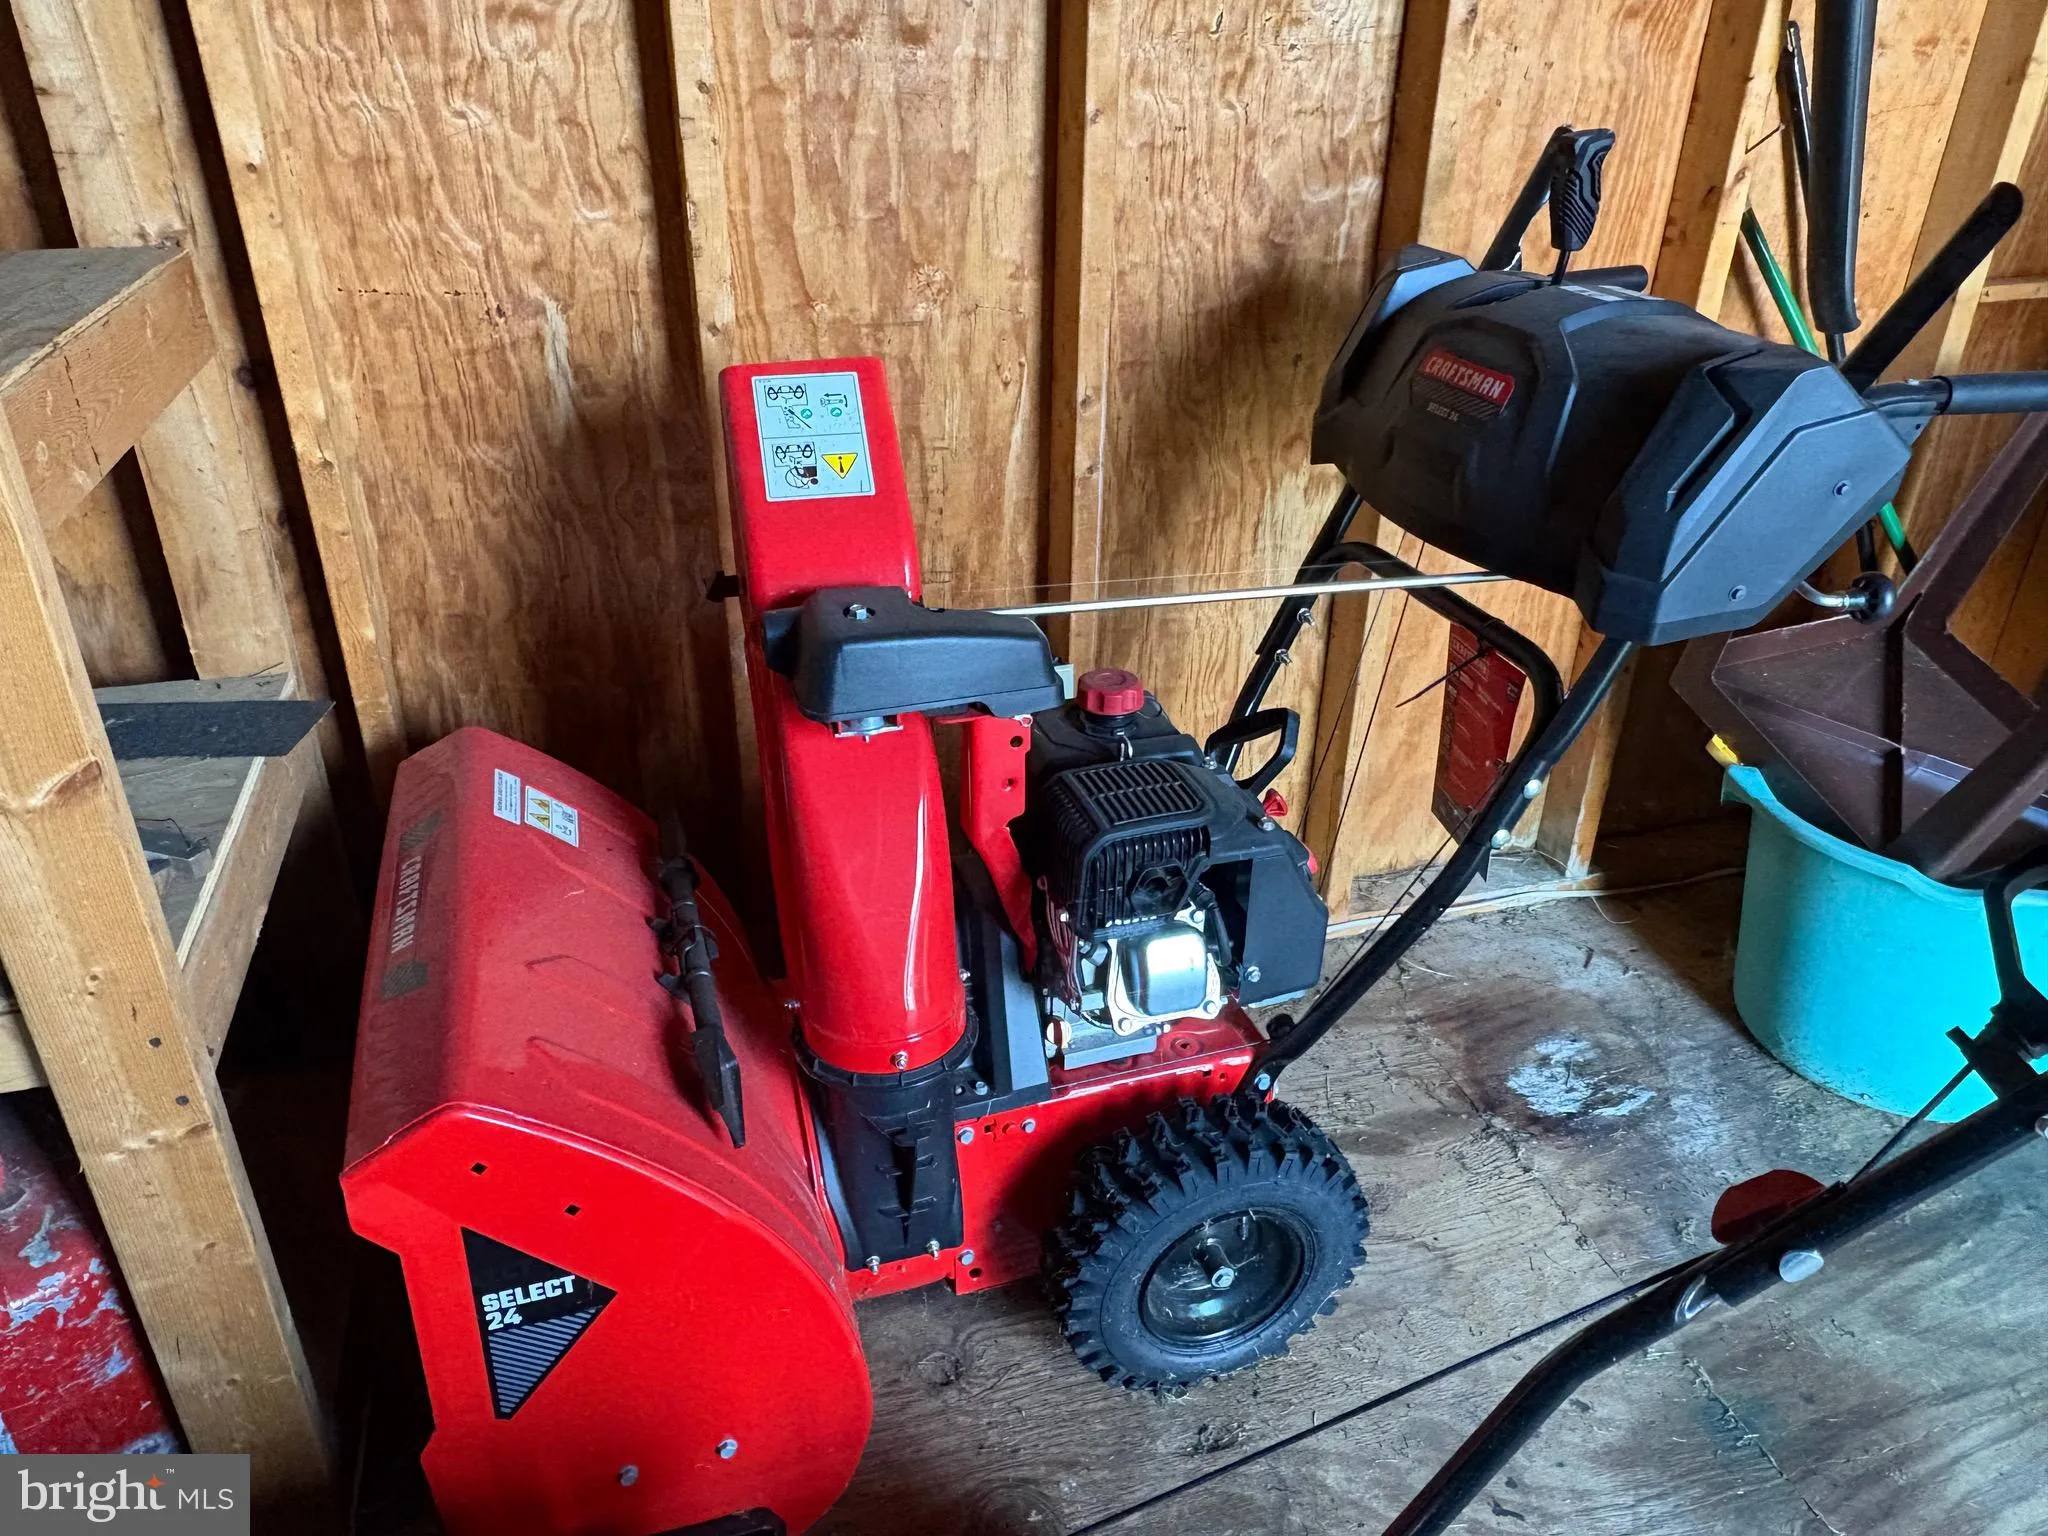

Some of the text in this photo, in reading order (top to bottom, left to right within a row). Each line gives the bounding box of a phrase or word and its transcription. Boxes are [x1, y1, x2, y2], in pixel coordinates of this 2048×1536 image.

[1424, 356, 1506, 399] CRAFTSMAN
[391, 855, 422, 954] CRAFTSMAN
[481, 1275, 576, 1313] SELECT
[485, 1307, 523, 1331] 24
